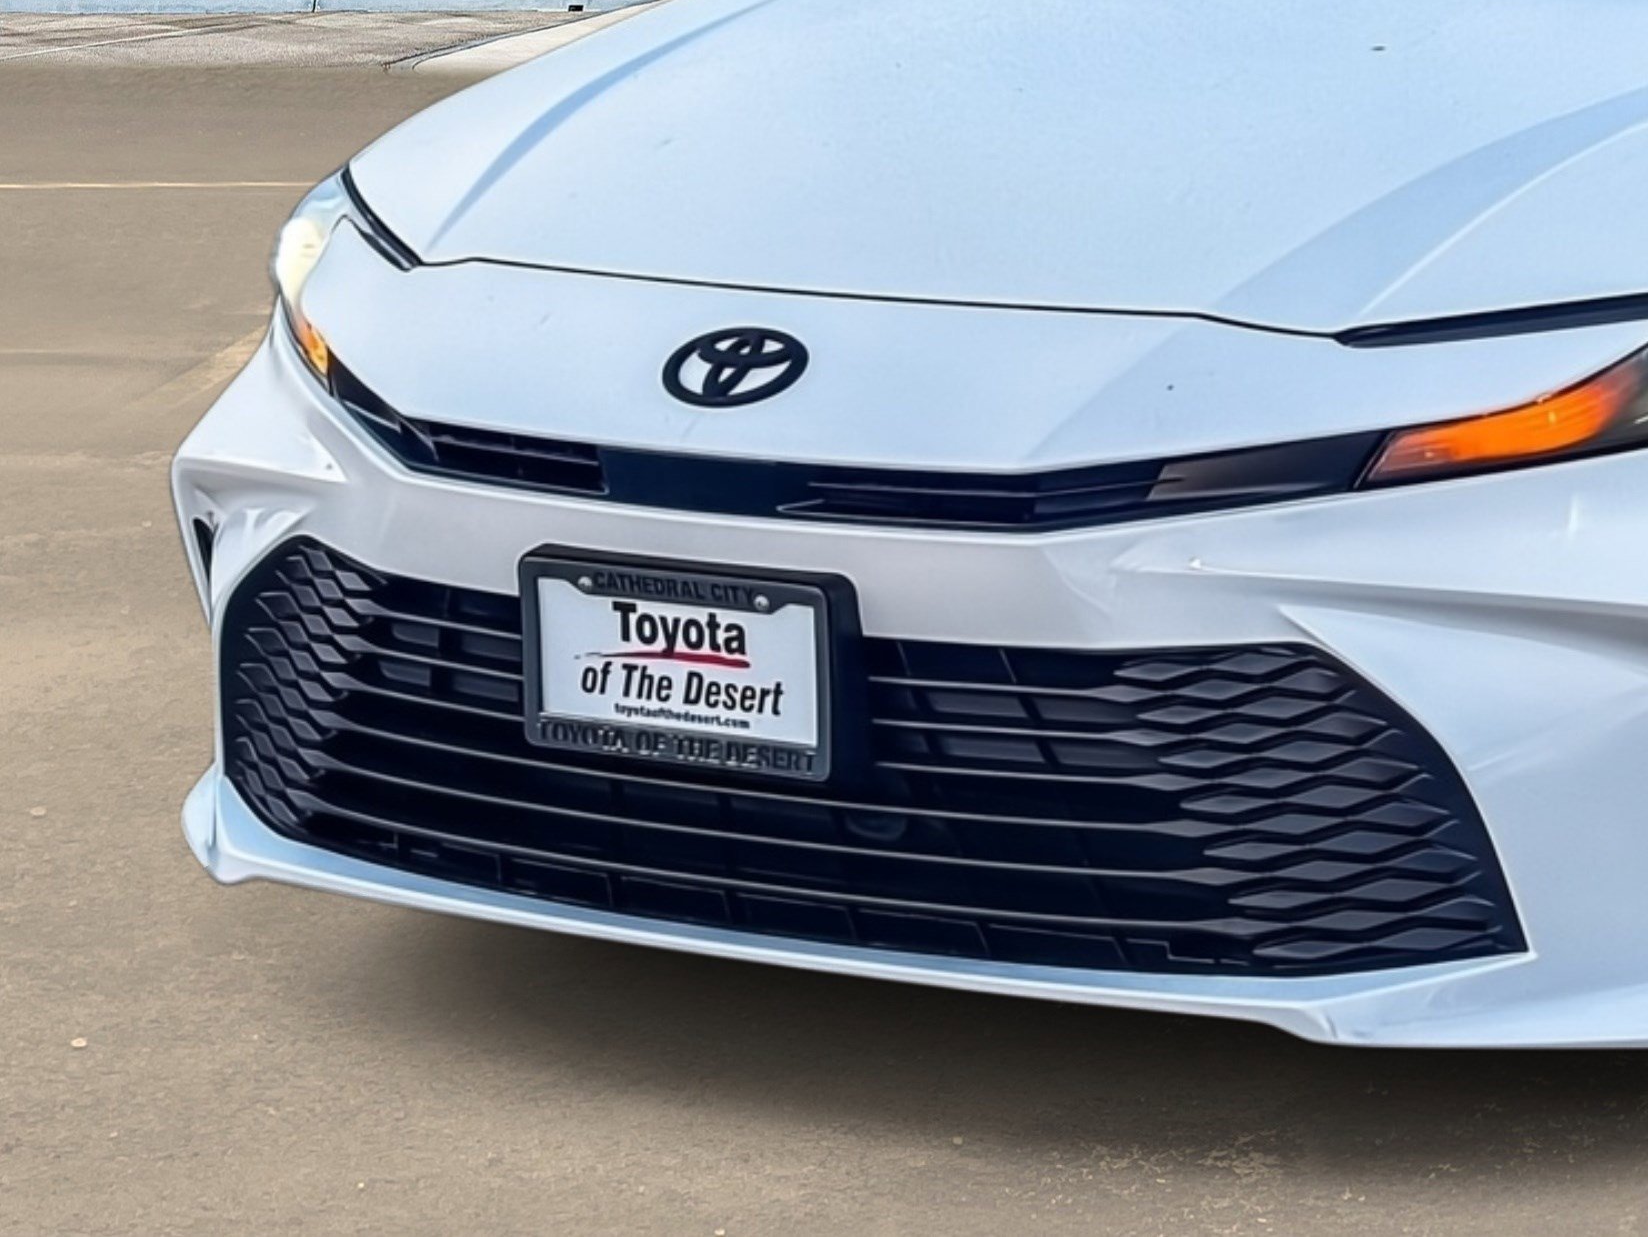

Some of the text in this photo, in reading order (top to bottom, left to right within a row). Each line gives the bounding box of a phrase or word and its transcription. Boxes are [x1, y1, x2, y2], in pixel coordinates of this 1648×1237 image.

[592, 572, 753, 604] CATHEDRAL CITY
[611, 601, 747, 656] Toyota
[581, 661, 784, 716] of The Desert
[614, 702, 750, 729] toyotaofthedesert.com
[538, 719, 817, 775] TOYOTA OF THE DESERT
